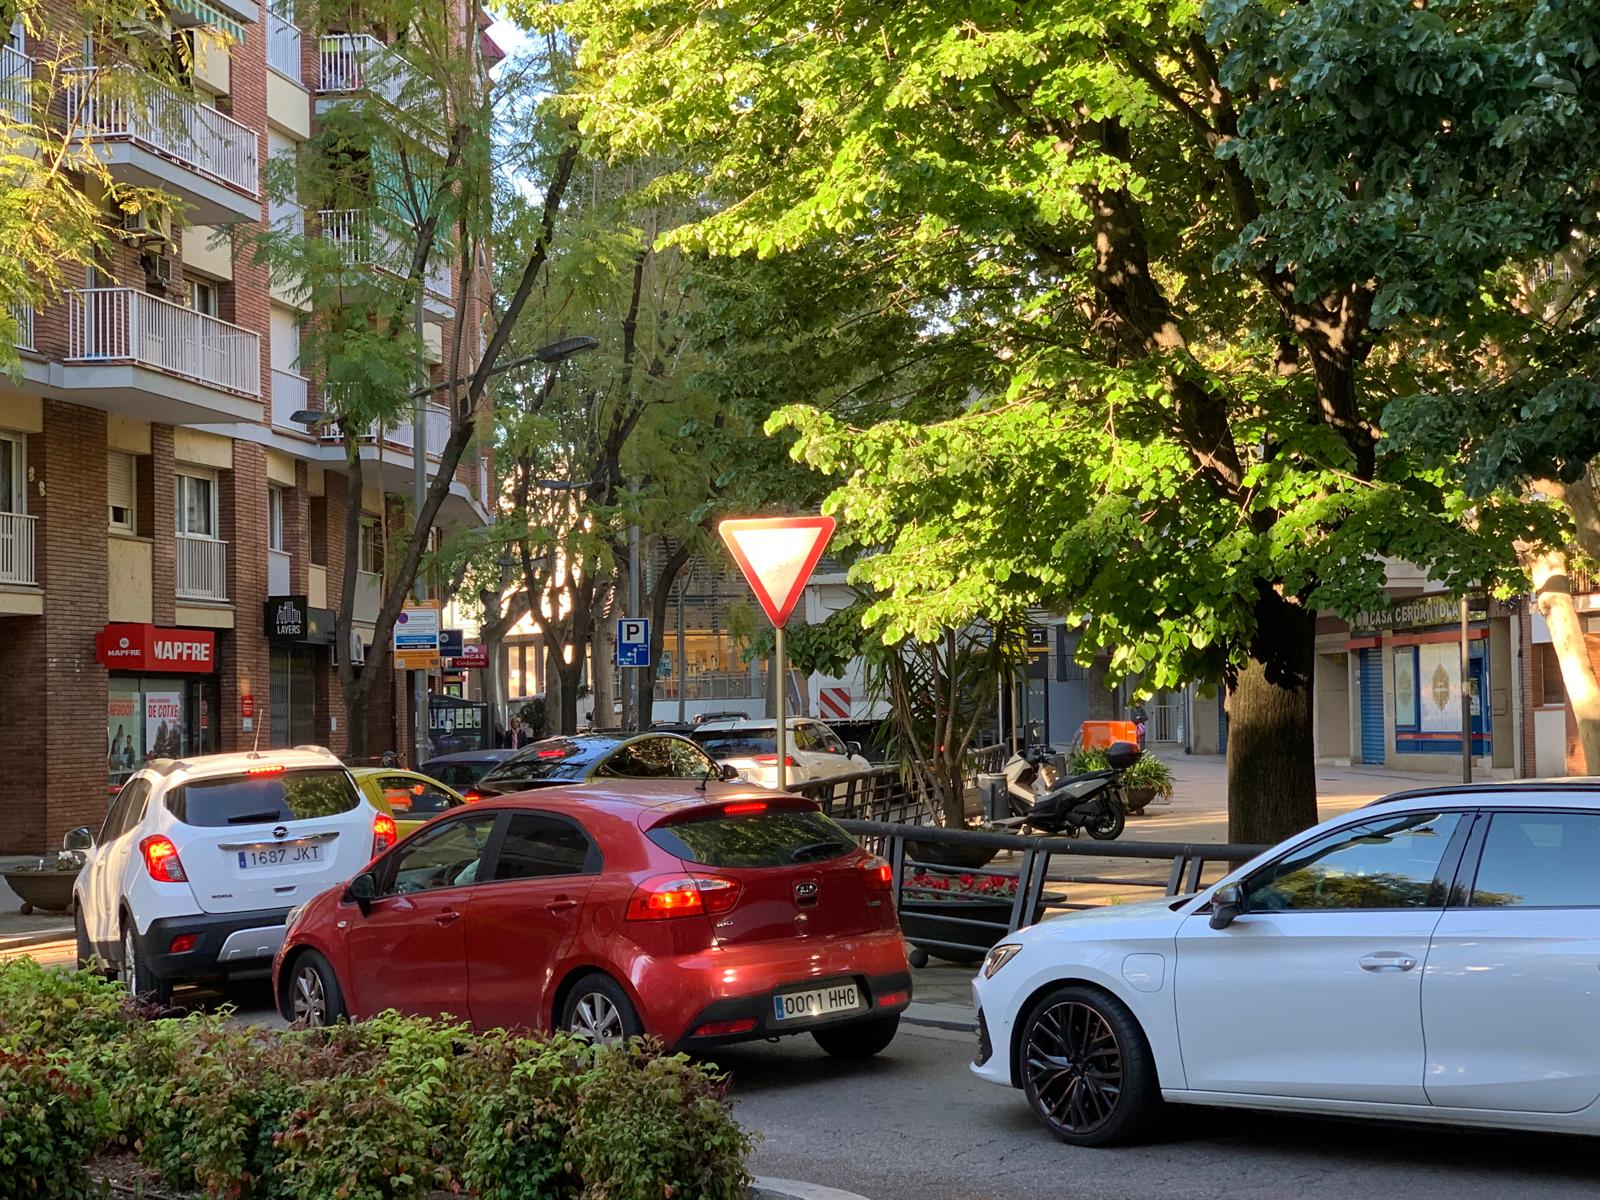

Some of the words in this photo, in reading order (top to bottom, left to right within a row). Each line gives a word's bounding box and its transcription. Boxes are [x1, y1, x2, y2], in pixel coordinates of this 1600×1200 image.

[1395, 600, 1459, 622] CERDANYOLA
[277, 624, 301, 635] LAYERS
[626, 623, 640, 641] P
[107, 649, 141, 657] MAPFRE
[153, 640, 210, 661] MAPFRE
[148, 704, 157, 718] DE
[158, 704, 179, 718] COTXE
[251, 850, 286, 866] 1687
[293, 846, 319, 861] JKT
[785, 992, 823, 1014] 0001
[828, 988, 856, 1008] HHG
